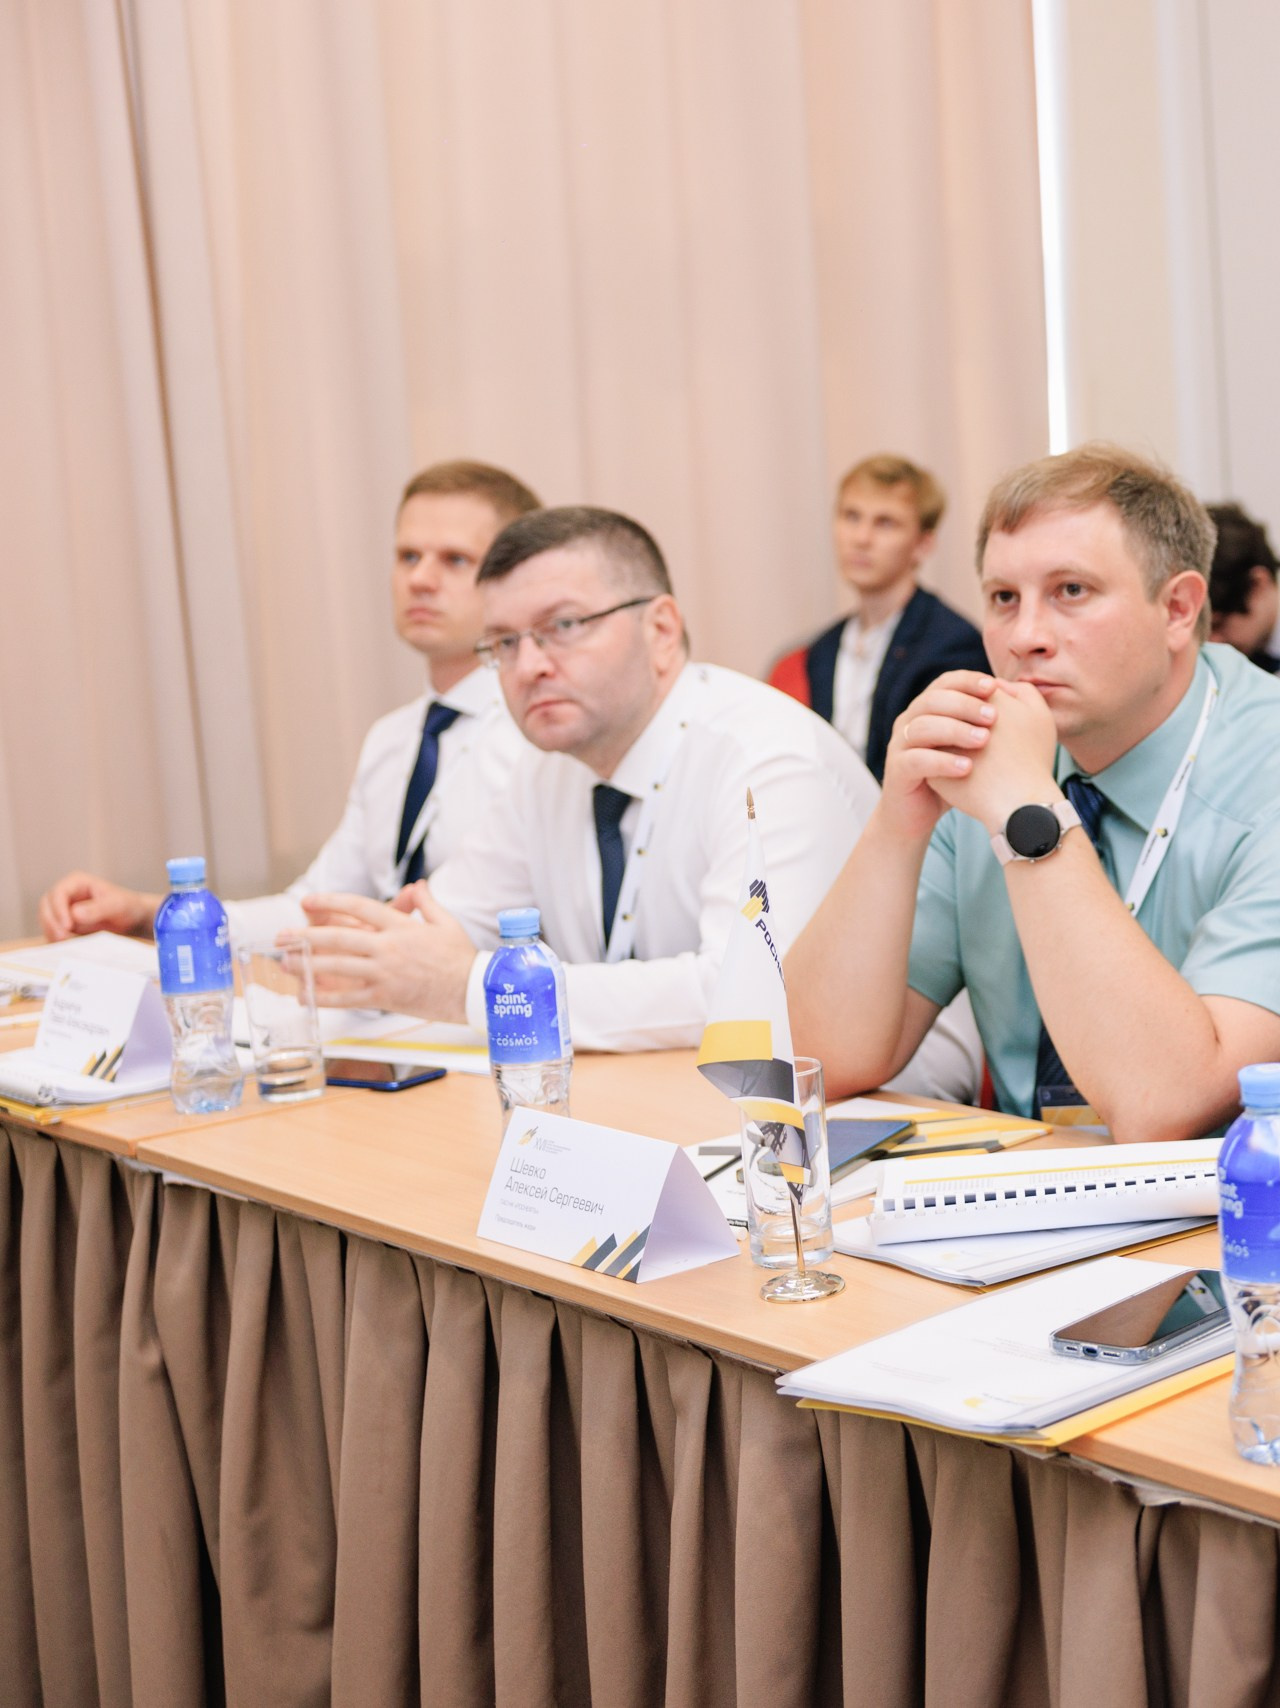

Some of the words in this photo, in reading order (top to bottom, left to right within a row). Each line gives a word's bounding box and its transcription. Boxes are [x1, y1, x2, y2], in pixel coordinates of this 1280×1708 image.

[495, 992, 528, 1005] saint
[493, 1004, 533, 1018] spring
[496, 1034, 539, 1047] COSMOS
[509, 1156, 547, 1180] Шевко
[504, 1176, 548, 1200] Алексей
[548, 1187, 605, 1215] Сергеевич
